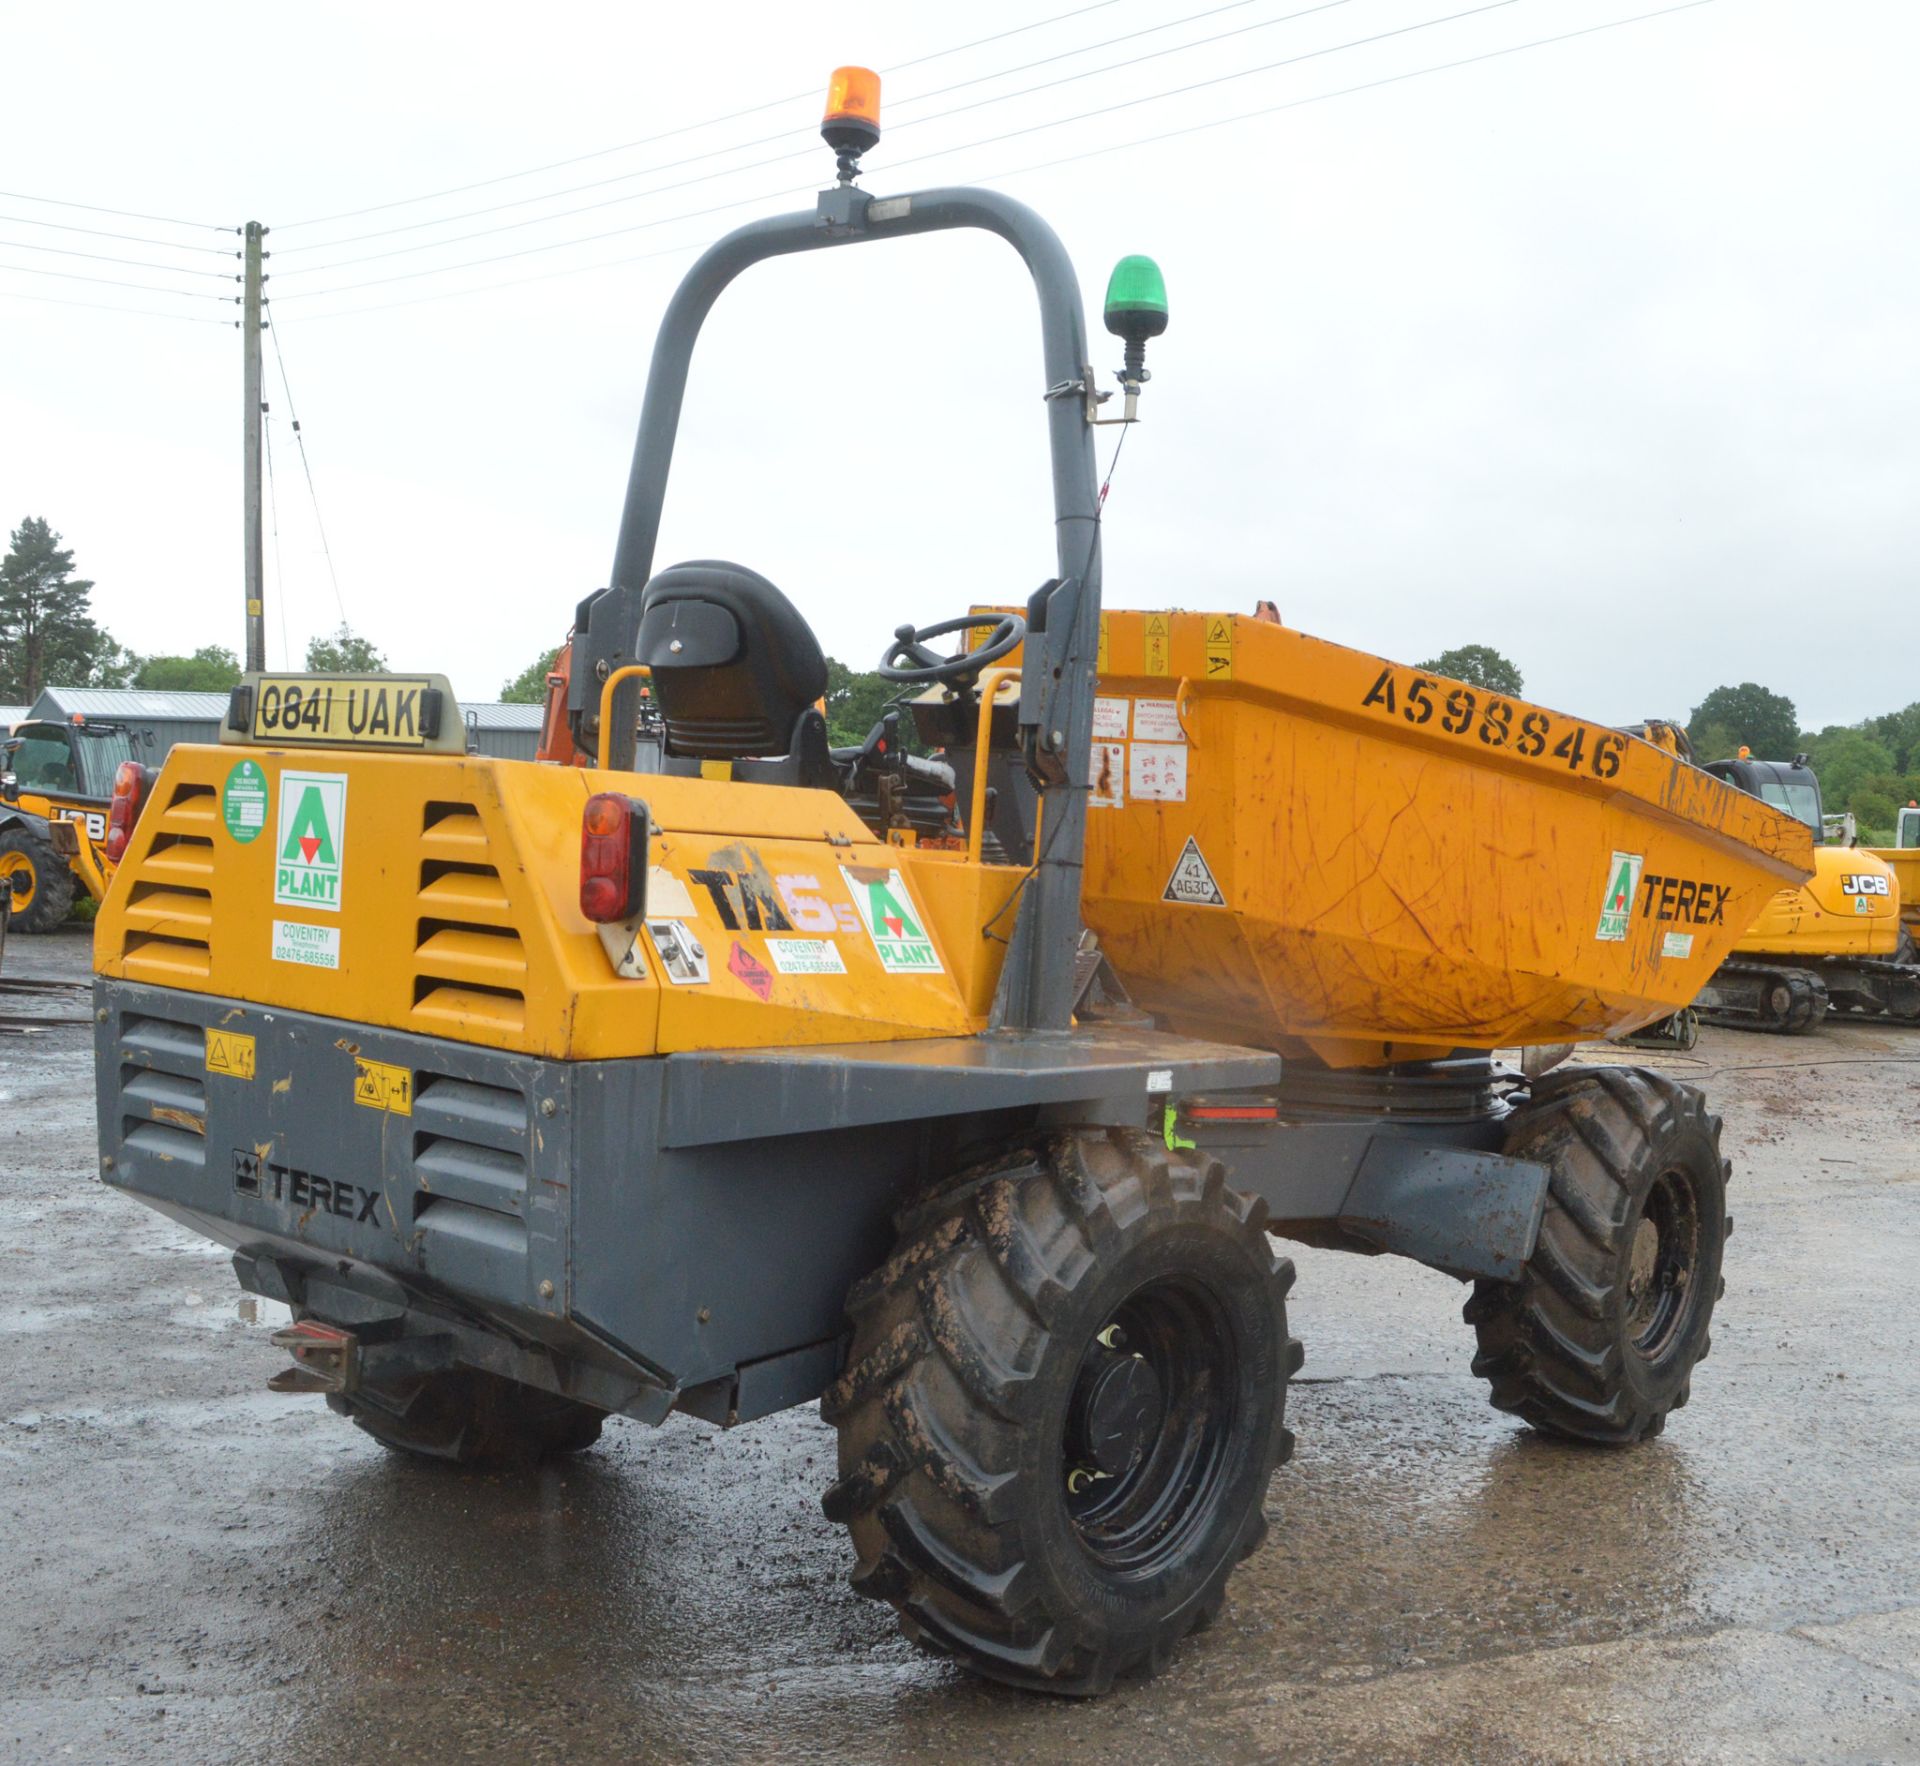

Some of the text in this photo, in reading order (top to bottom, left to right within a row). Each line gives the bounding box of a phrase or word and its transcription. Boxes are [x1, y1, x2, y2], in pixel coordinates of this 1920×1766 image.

[348, 688, 417, 736] UAK
[1361, 668, 1624, 778] A598846
[282, 786, 336, 864] A
[278, 869, 338, 899] PLANT
[1185, 864, 1200, 878] 41
[1605, 861, 1632, 911] A
[1842, 875, 1889, 895] JCB
[1177, 880, 1209, 895] AG3C
[1642, 874, 1732, 926] TEREX
[283, 924, 330, 944] COVENTRY
[777, 941, 828, 953] COVENTRY
[877, 944, 935, 963] PLANT
[267, 1163, 381, 1228] TEREX
